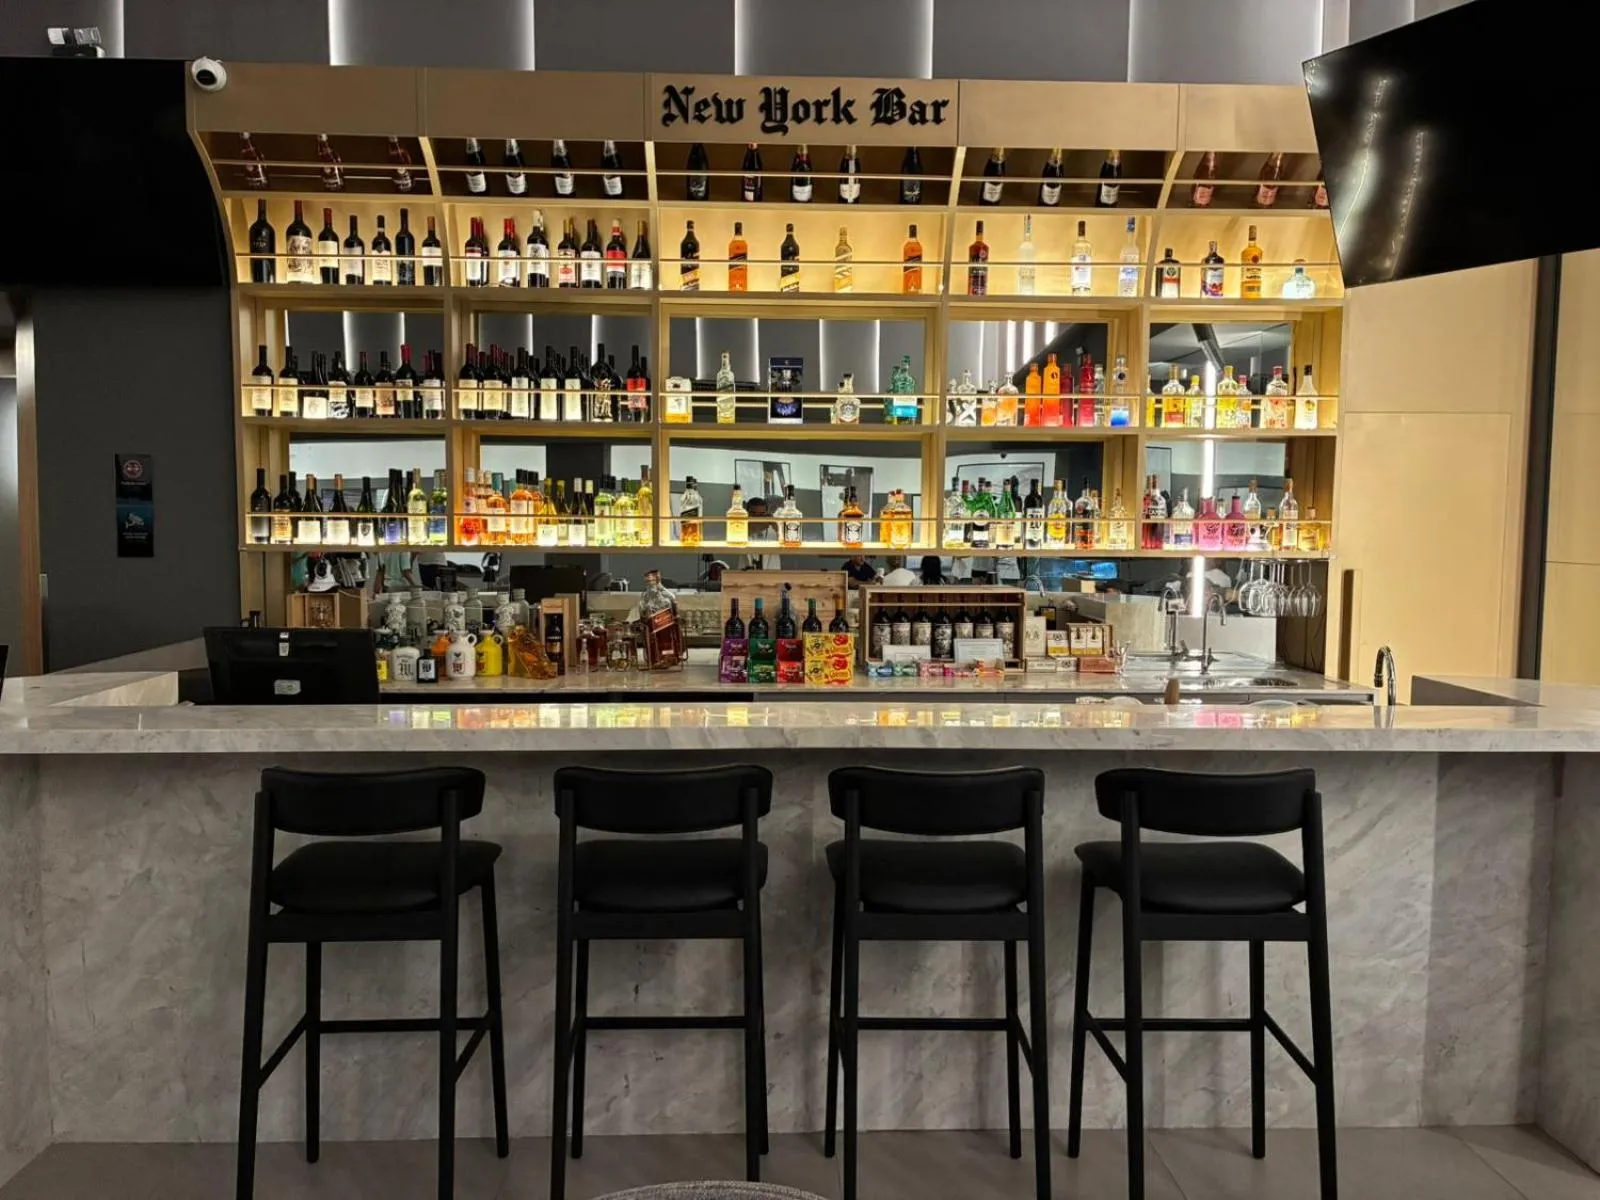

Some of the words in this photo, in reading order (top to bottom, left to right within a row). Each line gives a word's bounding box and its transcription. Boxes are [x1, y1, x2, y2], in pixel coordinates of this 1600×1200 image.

[661, 84, 747, 127] New
[758, 86, 858, 136] York
[870, 87, 950, 126] Bar
